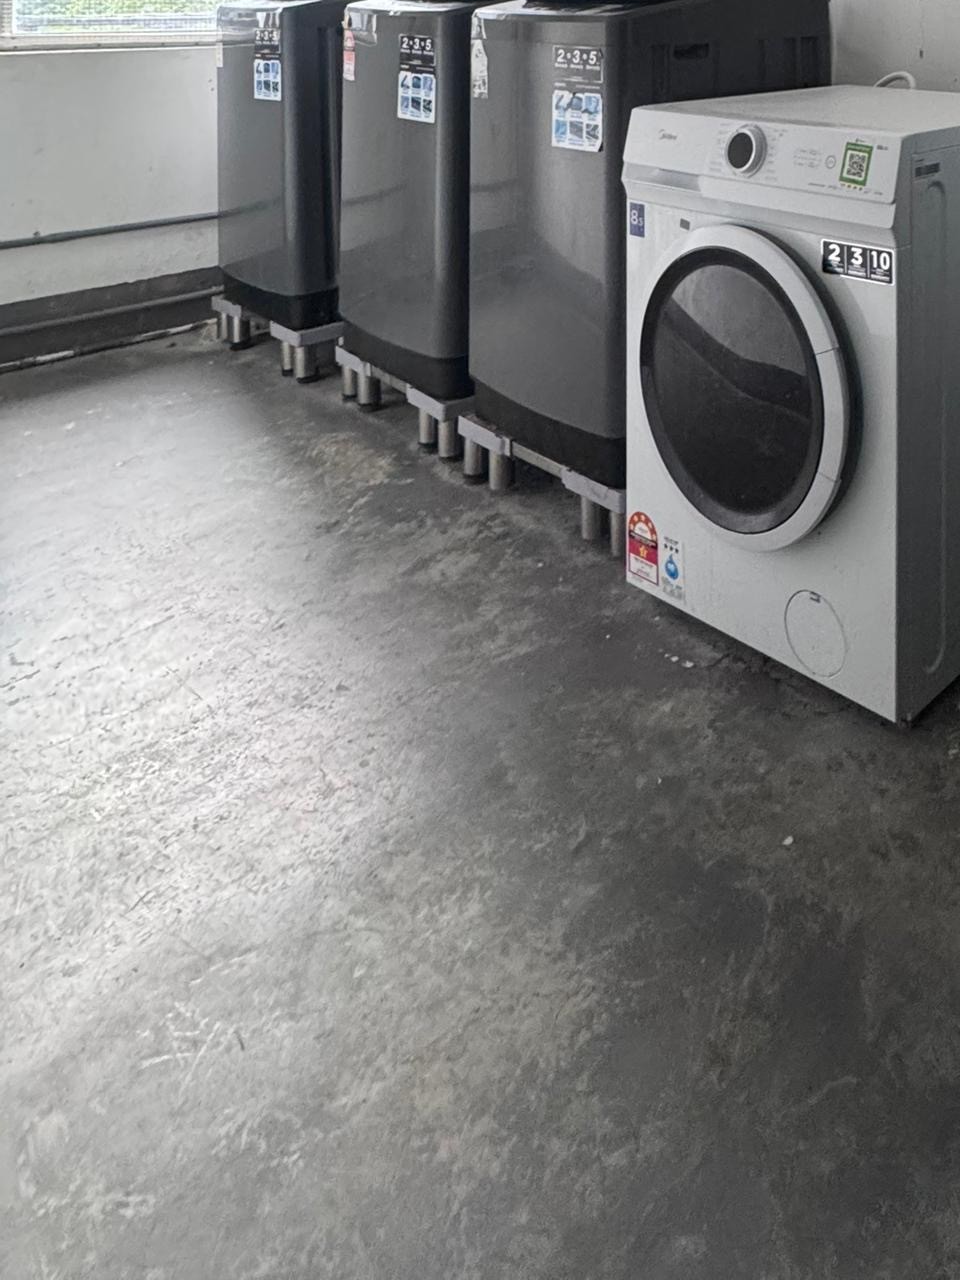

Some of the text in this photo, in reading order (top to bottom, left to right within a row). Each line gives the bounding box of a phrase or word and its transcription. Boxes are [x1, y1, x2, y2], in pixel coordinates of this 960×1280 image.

[401, 36, 432, 51] 2 3 5
[557, 49, 597, 65] 2 3 5
[828, 243, 841, 261] 2
[850, 247, 863, 265] 3
[871, 250, 890, 270] 10
